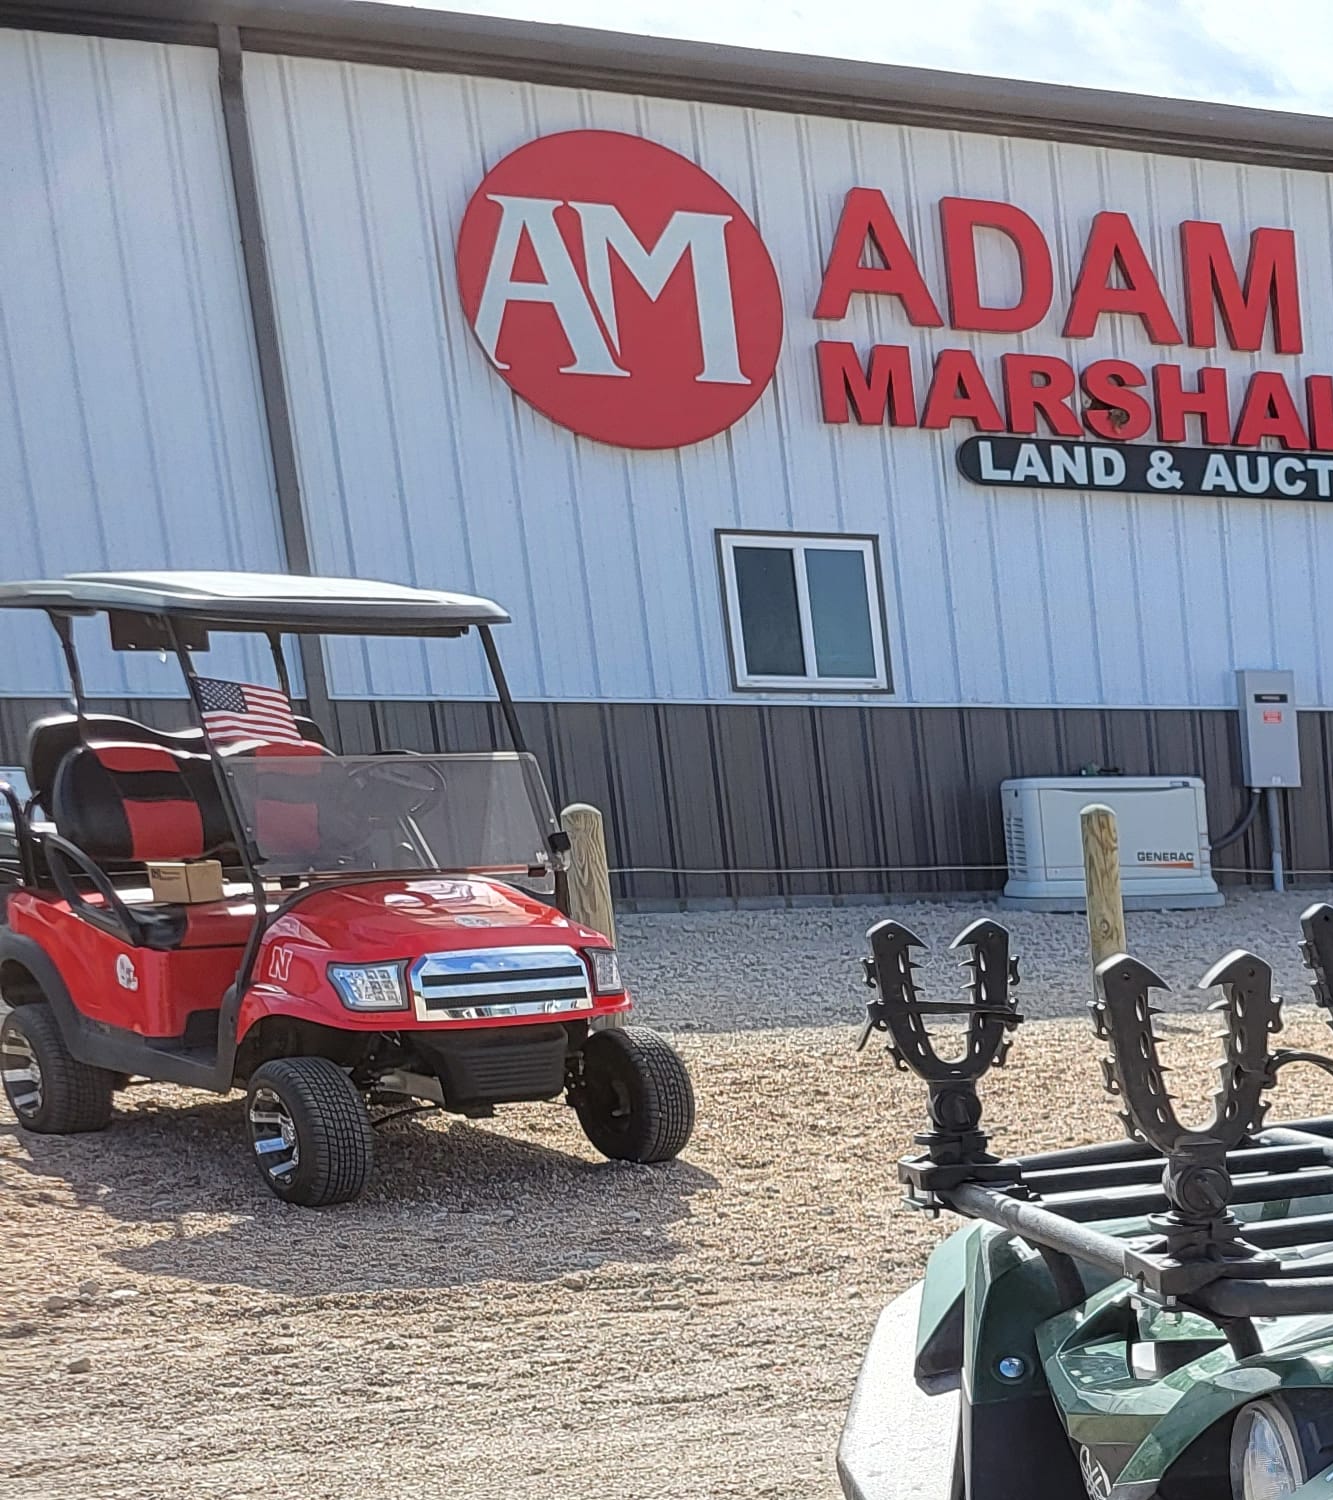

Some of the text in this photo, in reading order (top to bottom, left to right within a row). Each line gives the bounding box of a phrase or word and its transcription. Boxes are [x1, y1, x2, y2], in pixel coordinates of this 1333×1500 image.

[473, 192, 752, 385] AM
[812, 186, 1303, 356] ADAM
[978, 435, 1128, 489] LAND
[1145, 449, 1184, 491] &
[1136, 851, 1195, 862] GENERAC
[268, 944, 294, 982] N
